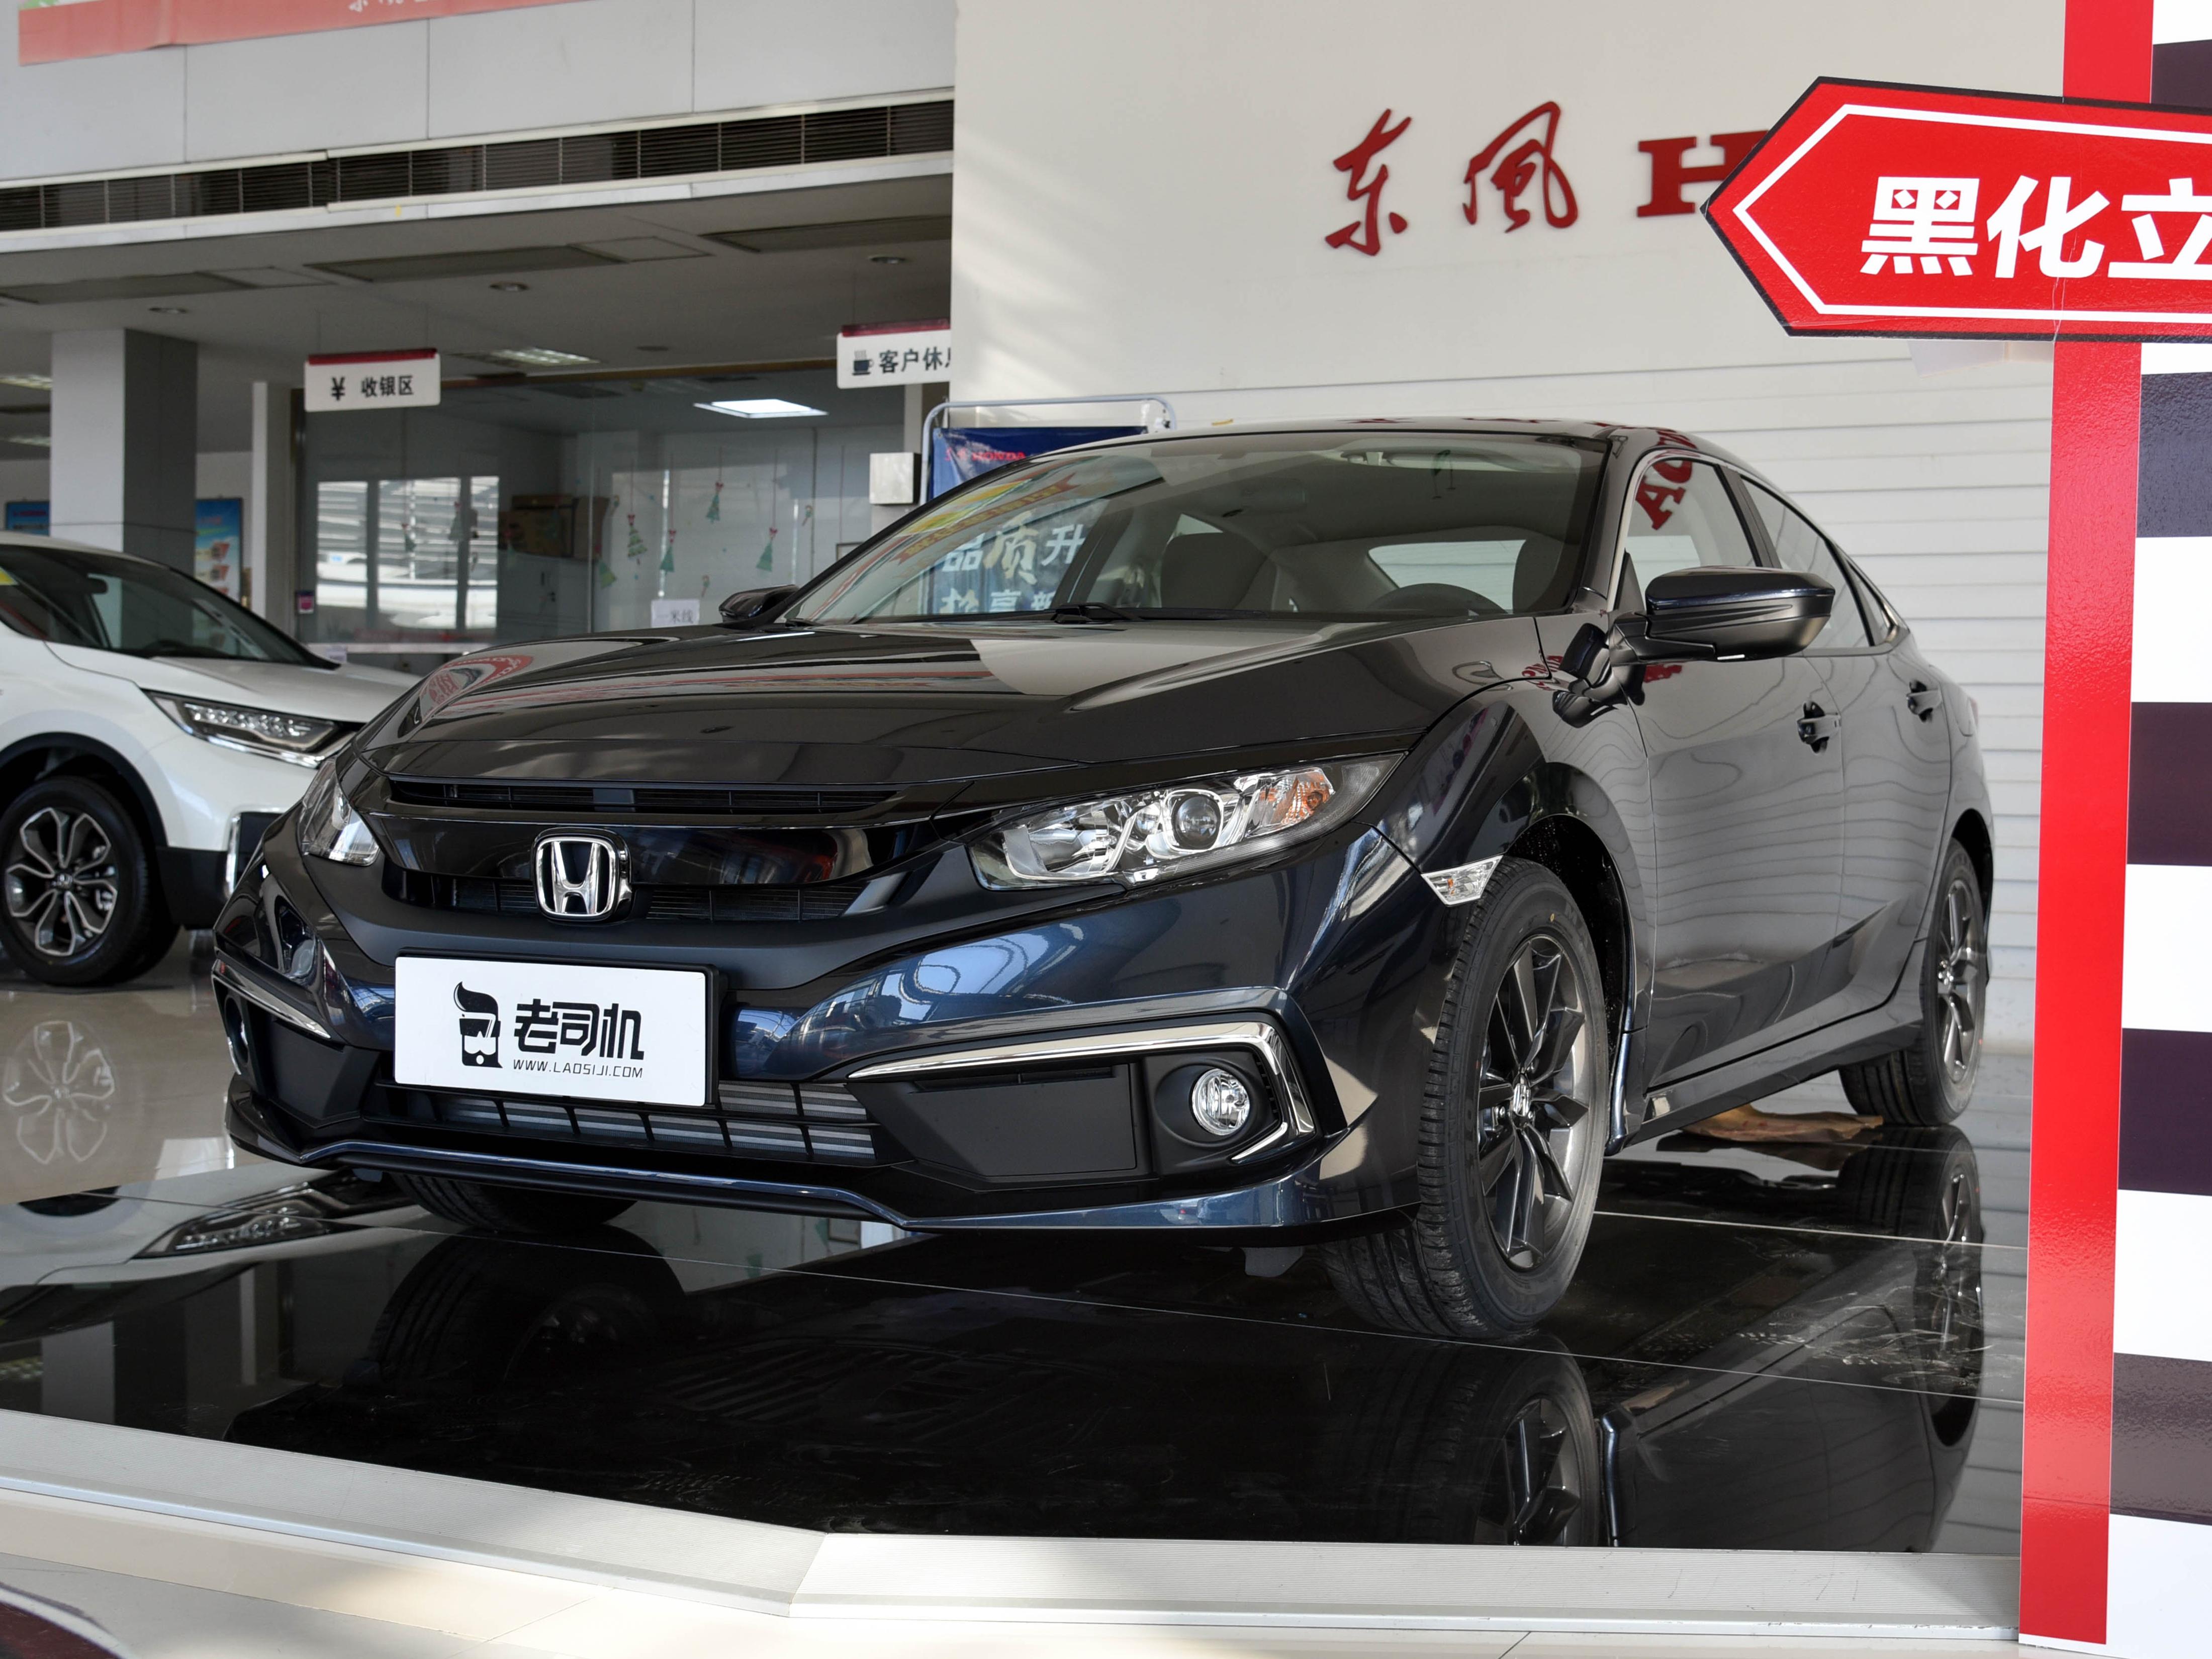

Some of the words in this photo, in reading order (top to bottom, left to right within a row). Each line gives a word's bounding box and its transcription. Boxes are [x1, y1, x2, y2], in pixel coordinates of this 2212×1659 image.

[1324, 101, 1579, 256] 东风
[1861, 175, 2212, 281] 黑化立
[879, 346, 951, 374] 客户休
[360, 375, 414, 398] 收银区
[971, 451, 1026, 462] HONDA
[514, 998, 644, 1060] 老司机
[513, 1059, 643, 1078] WWW.LAOSIJI.COM
